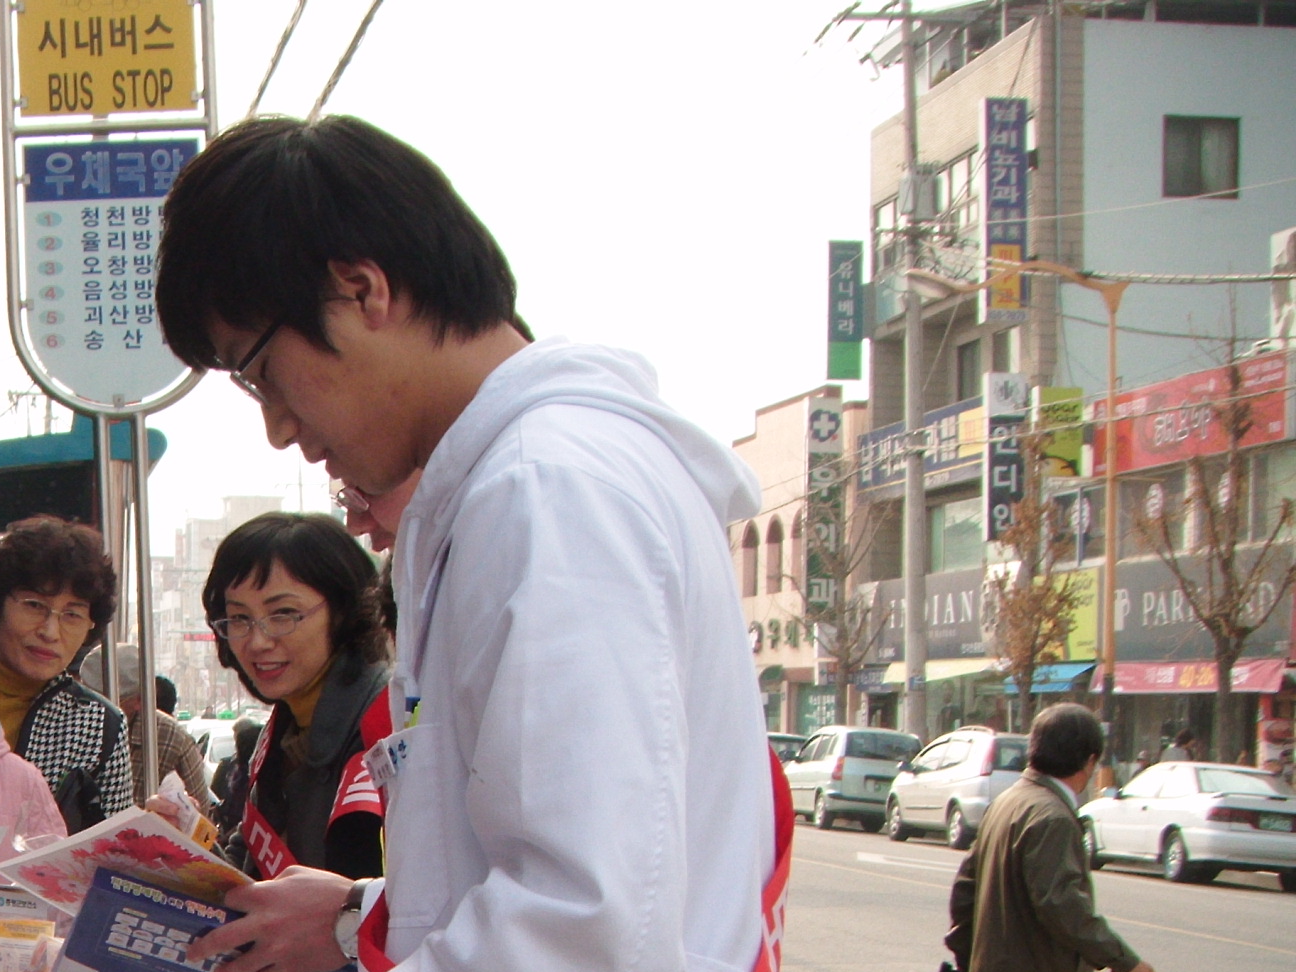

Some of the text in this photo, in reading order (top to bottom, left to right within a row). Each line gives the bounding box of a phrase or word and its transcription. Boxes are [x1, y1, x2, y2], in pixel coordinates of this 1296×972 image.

[38, 14, 175, 59] 시내버스
[48, 68, 173, 113] BUS STOP
[45, 148, 184, 195] 우체국앞
[43, 214, 53, 226] 1
[45, 231, 164, 252] 2 율리방
[46, 262, 56, 274] 3
[44, 286, 56, 299] 4
[838, 262, 855, 335] 유니베라
[46, 311, 57, 324] 5
[46, 335, 57, 347] 6
[992, 426, 1018, 531] 인디안
